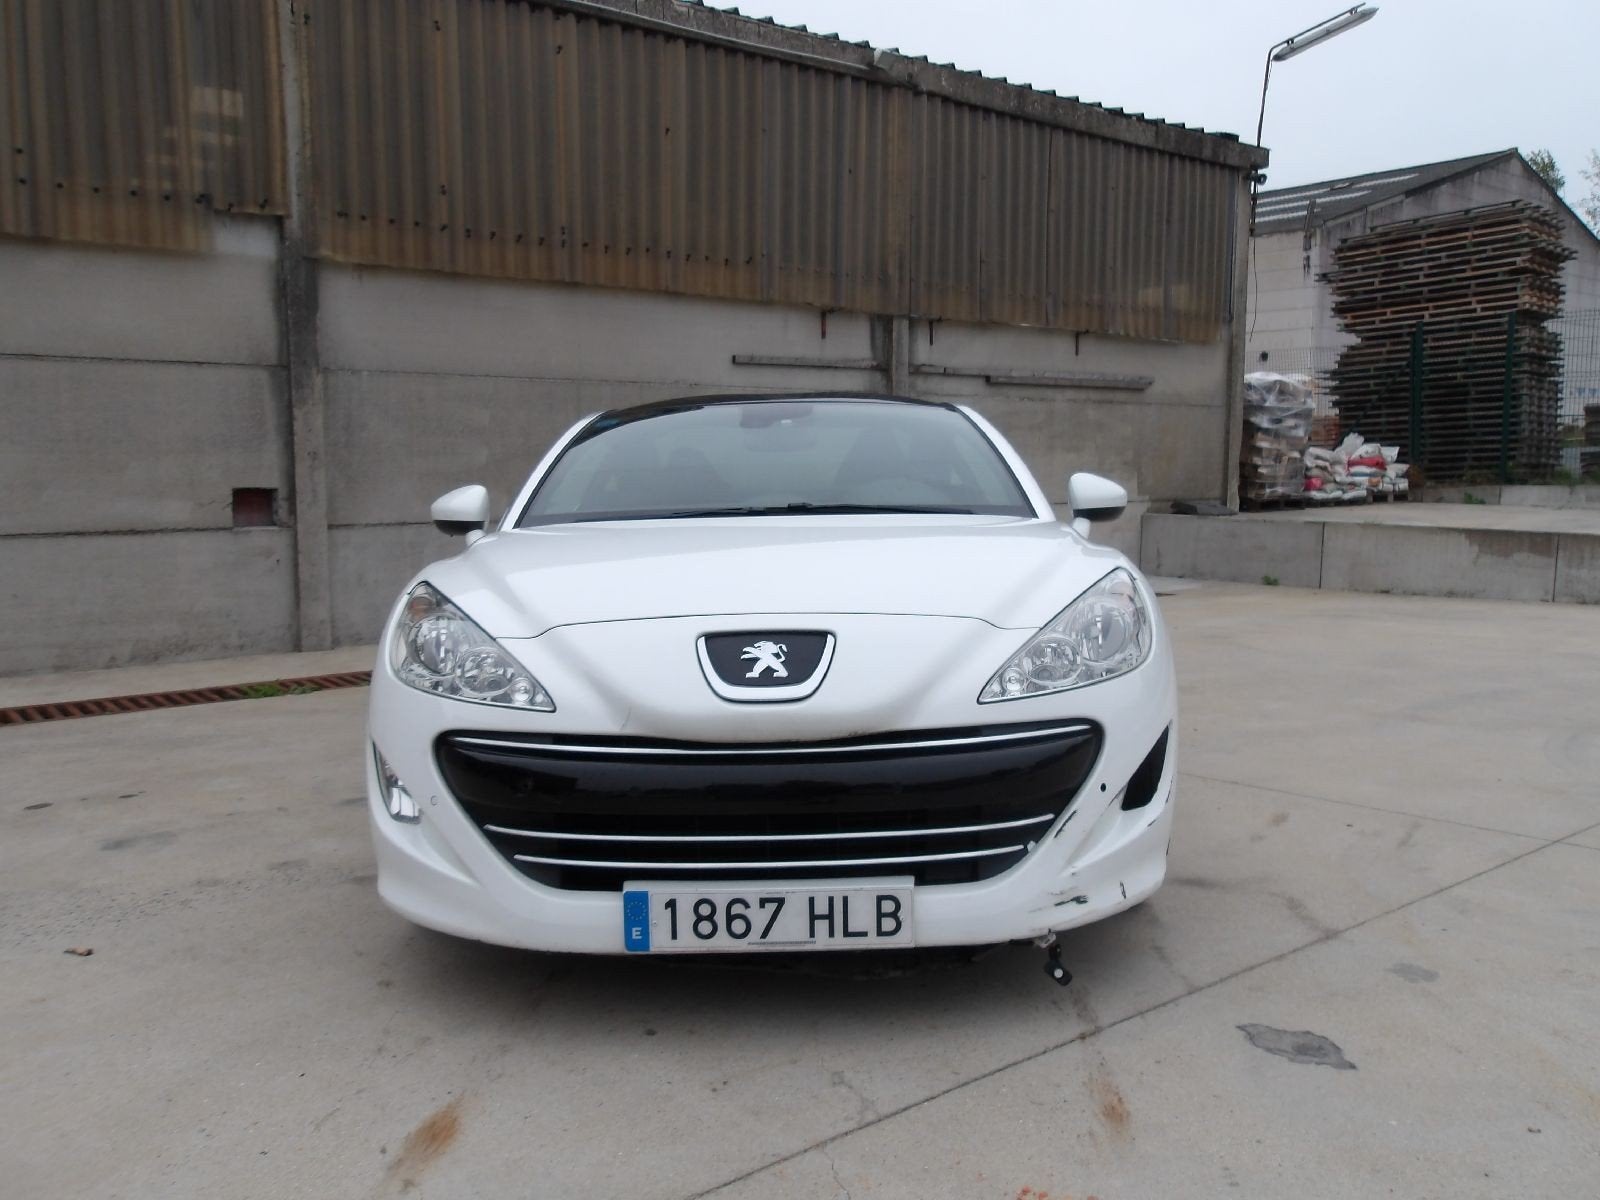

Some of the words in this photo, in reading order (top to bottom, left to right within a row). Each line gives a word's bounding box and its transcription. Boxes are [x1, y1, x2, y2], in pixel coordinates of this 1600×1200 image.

[664, 897, 786, 940] 1867
[808, 894, 903, 938] HLB
[631, 927, 643, 939] E
